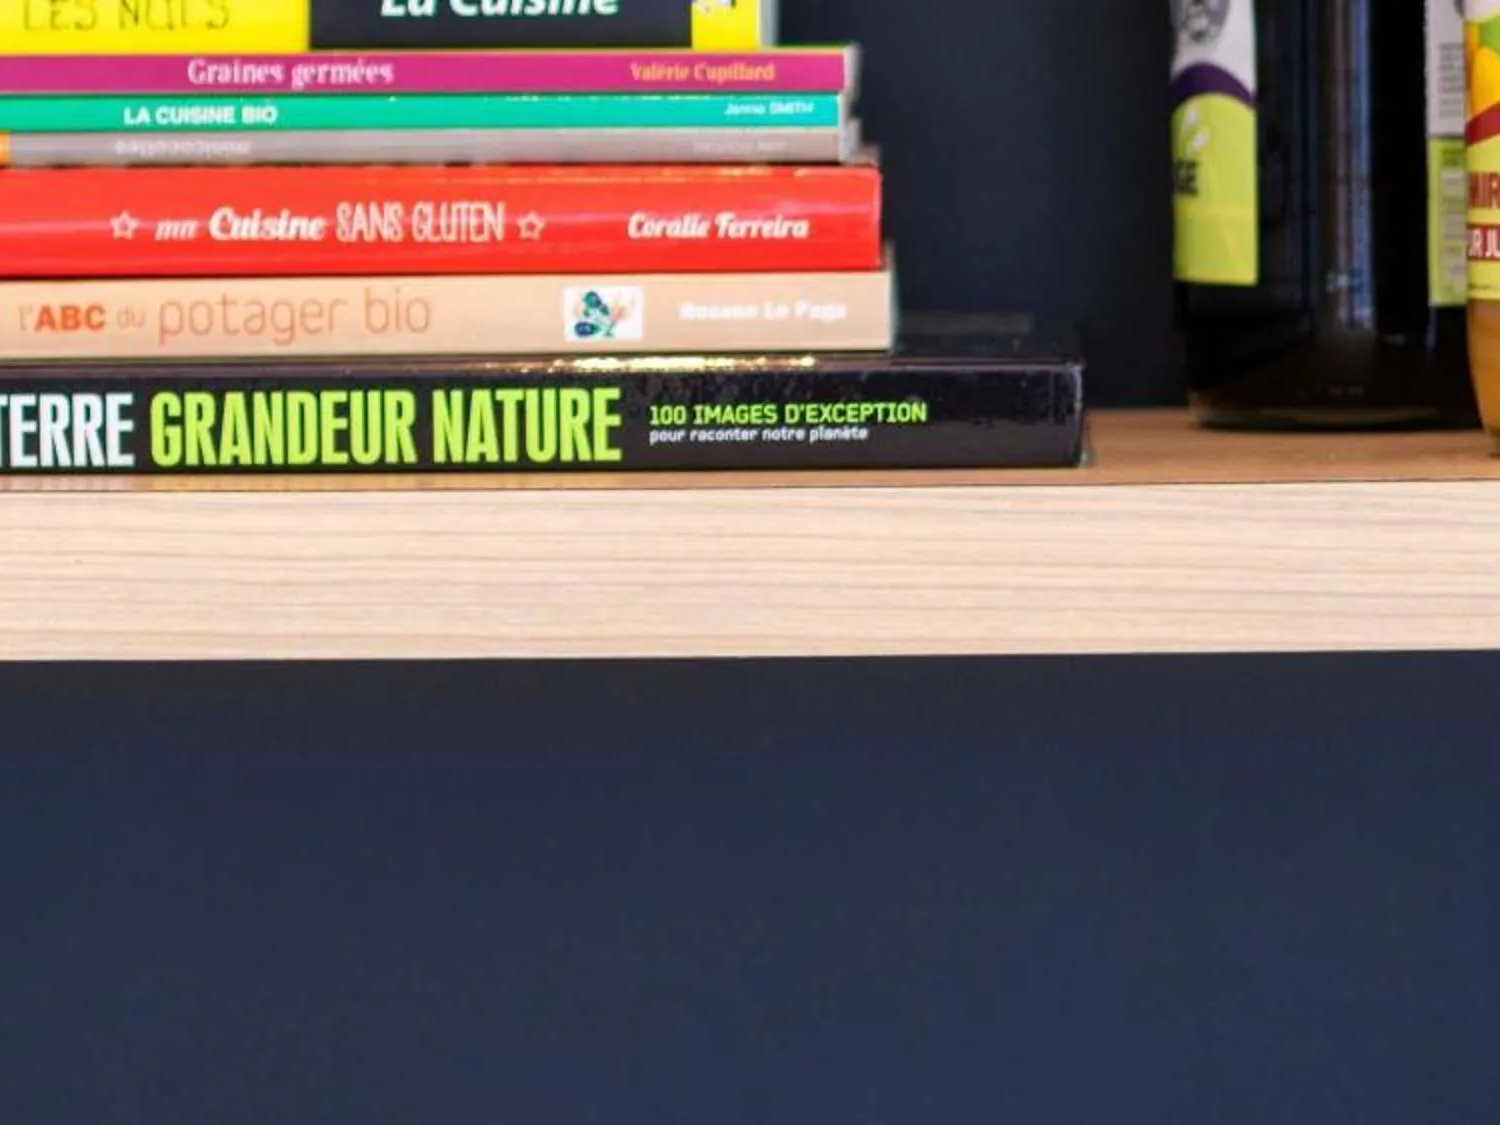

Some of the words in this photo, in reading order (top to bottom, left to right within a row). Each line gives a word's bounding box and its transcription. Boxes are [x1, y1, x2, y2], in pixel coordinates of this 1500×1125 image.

[187, 58, 283, 86] Graines
[290, 57, 394, 92] germées
[123, 106, 150, 125] LA
[155, 105, 235, 125] CUISINE
[241, 104, 278, 124] BIO
[208, 206, 326, 242] Cuisine
[336, 202, 403, 242] SANS
[412, 201, 505, 242] GLUTEN
[628, 212, 709, 240] Coralie
[714, 211, 809, 240] Ferreira
[116, 303, 146, 329] du
[159, 296, 347, 345] potager
[364, 287, 432, 335] bio
[151, 390, 418, 467] GRANDEUR
[432, 387, 622, 463] NATURE
[650, 406, 686, 425] 100
[693, 405, 777, 425] IMAGES
[784, 402, 928, 423] D'EXCEPTION
[650, 428, 685, 445] pour
[690, 426, 757, 442] raconter
[762, 425, 805, 441] notre
